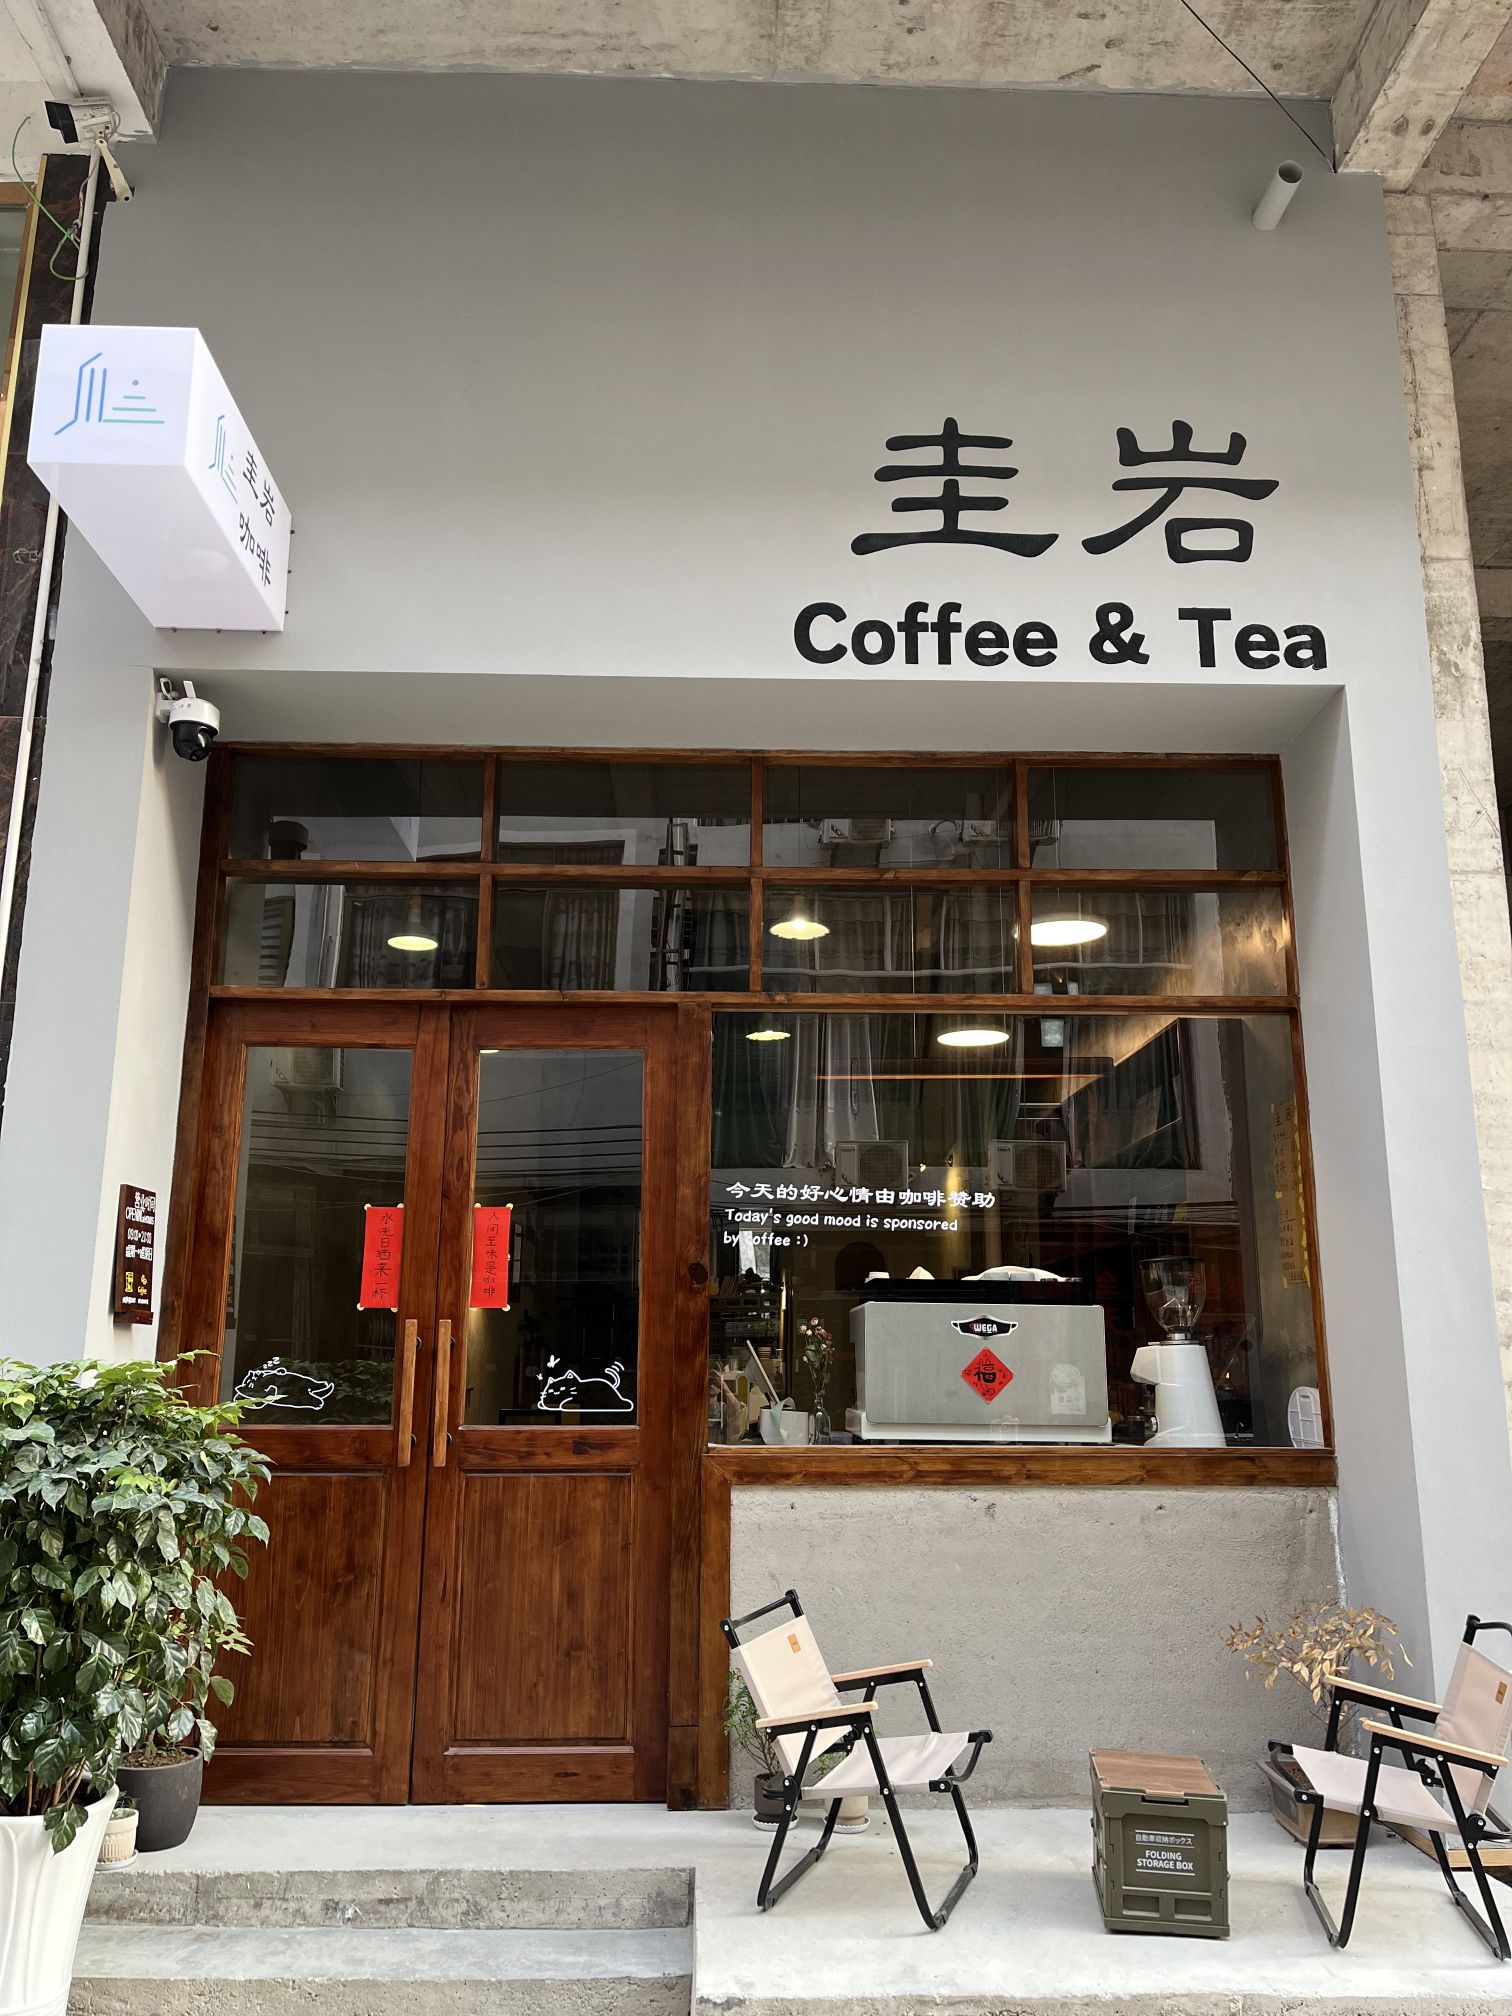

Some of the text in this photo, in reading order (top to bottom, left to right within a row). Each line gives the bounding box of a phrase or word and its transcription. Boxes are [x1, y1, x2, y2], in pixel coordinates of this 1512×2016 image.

[239, 512, 271, 586] 咖啡
[794, 602, 1328, 671] Coffee & Tea
[726, 1181, 996, 1209] 今天的好心情由咖啡赞助
[725, 1208, 958, 1232] Today's good mood is sponsored
[723, 1231, 740, 1247] by
[745, 1231, 791, 1247] coffee
[371, 1212, 395, 1300] 水洗日晒来一杯
[482, 1212, 499, 1298] 人间至味是咖啡
[974, 1323, 998, 1334] WEGA
[1136, 1858, 1194, 1871] STORAGE BOX
[1145, 1850, 1182, 1860] FOLDING
